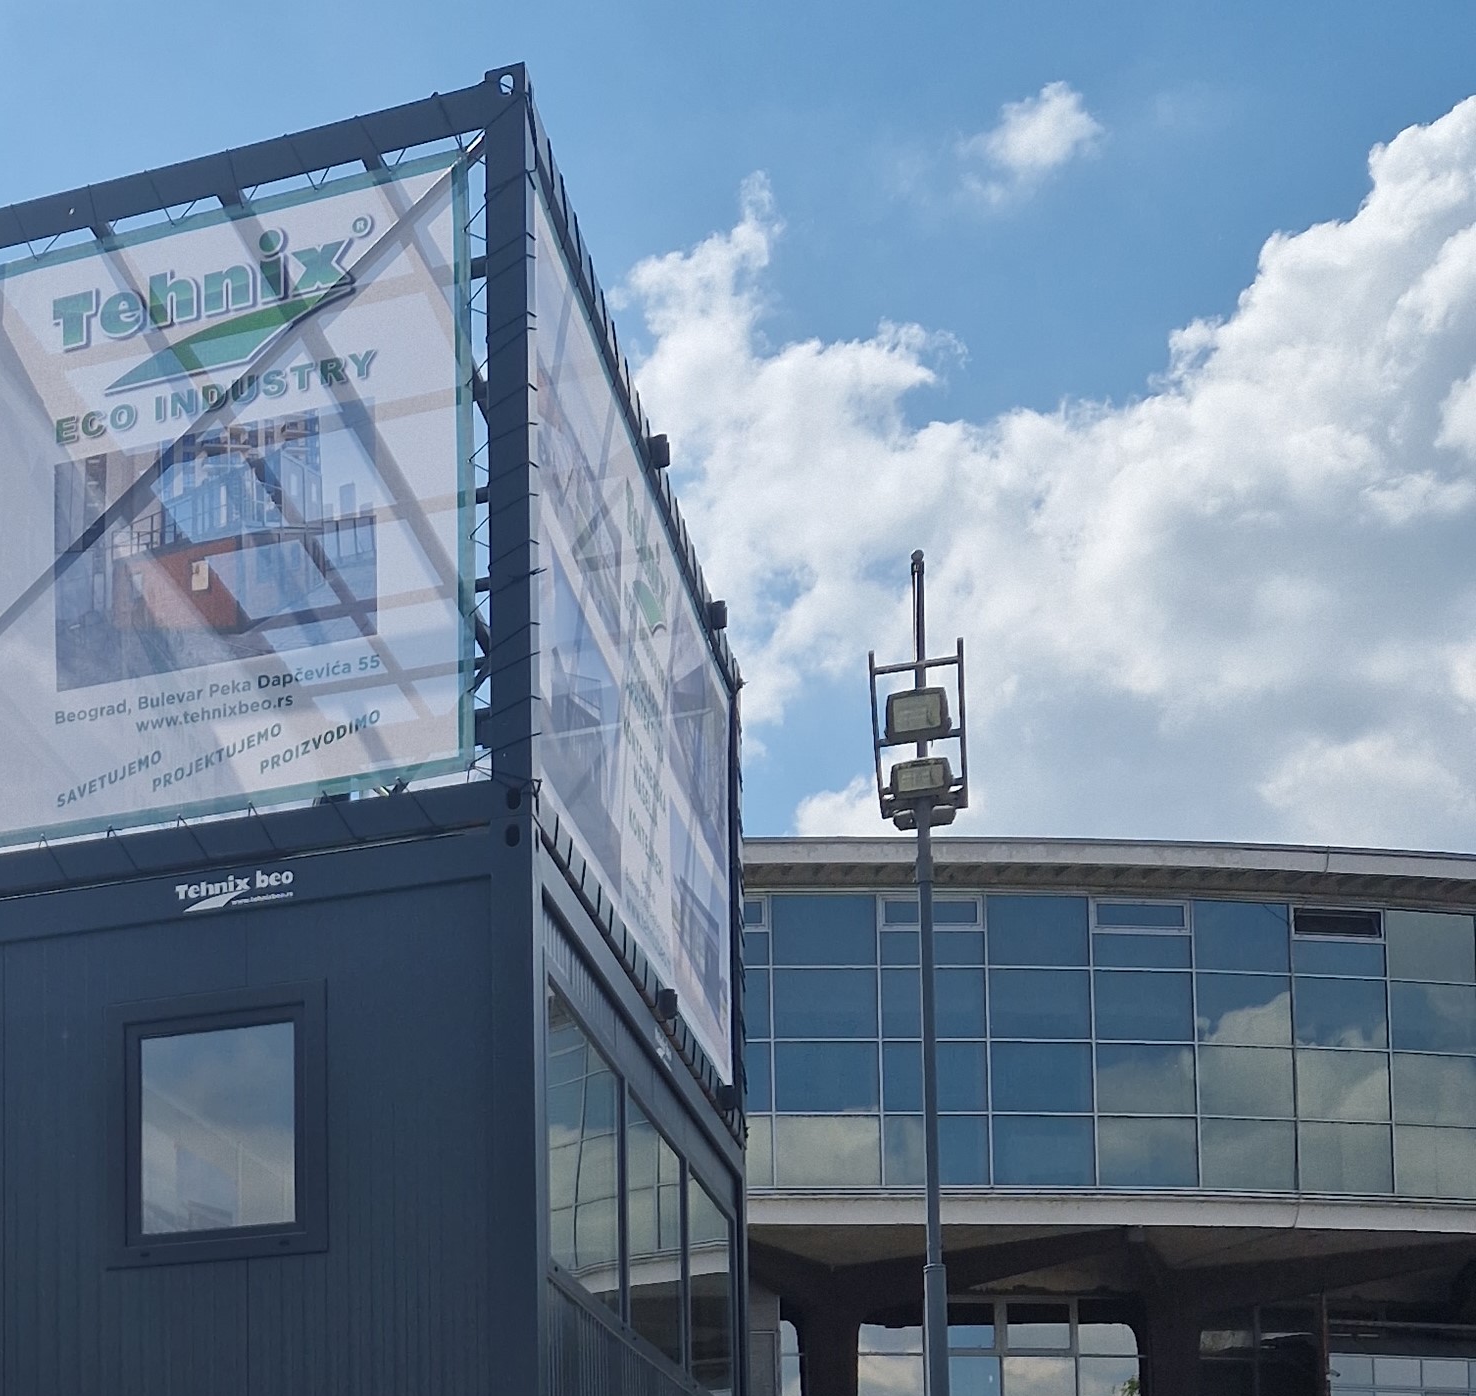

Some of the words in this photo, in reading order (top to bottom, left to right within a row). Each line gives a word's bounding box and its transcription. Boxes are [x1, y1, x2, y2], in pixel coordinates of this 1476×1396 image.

[55, 404, 138, 445] ECO
[154, 350, 378, 422] INDUSTRY
[55, 698, 132, 725] Beograd,
[137, 687, 204, 711] Bulevar
[208, 677, 253, 699] Peka
[257, 660, 352, 691] Dapčevića
[357, 653, 381, 672] 55
[135, 693, 294, 733] www.tehnixbeo.rs
[56, 750, 163, 808] SAVETUJEMO
[151, 722, 282, 793] PROJEKTUJEMO
[259, 709, 381, 775] PROIZVODIMO
[175, 874, 251, 900] Tehnix
[255, 870, 294, 889] beo
